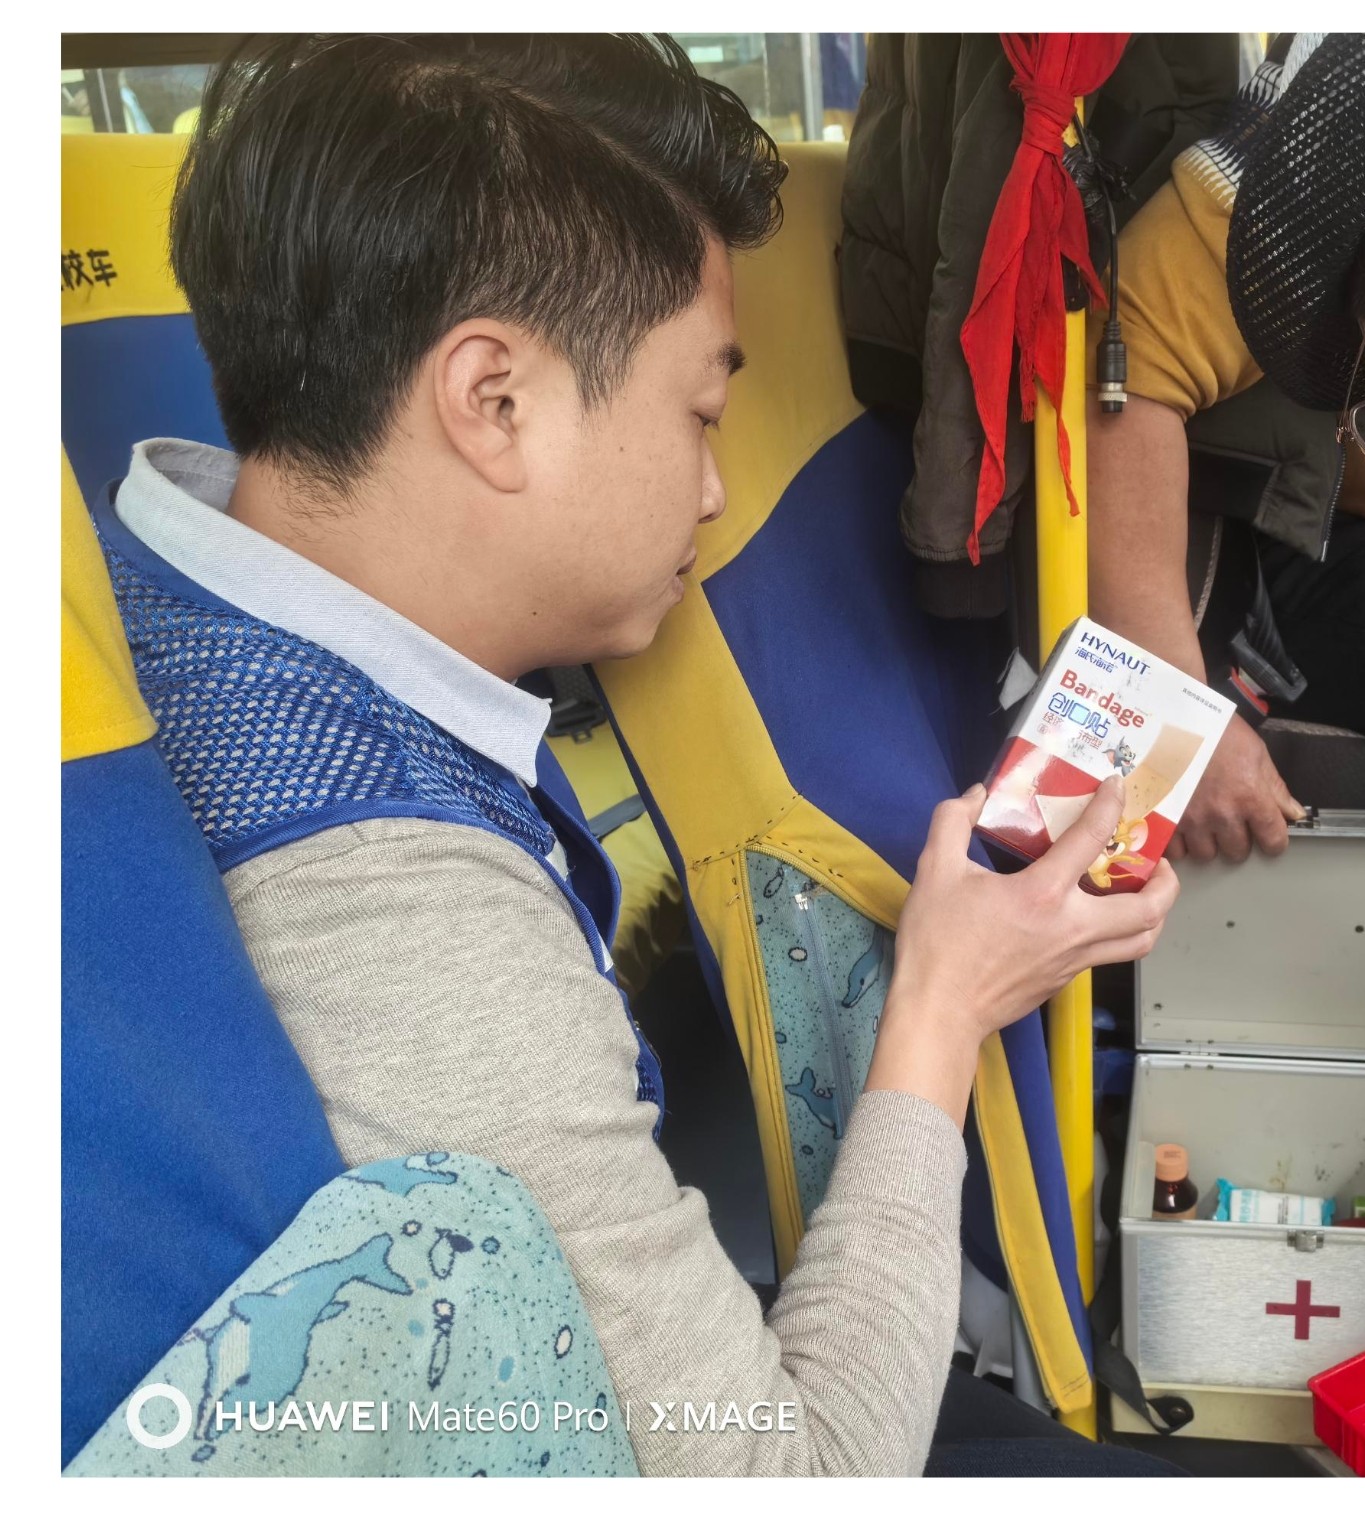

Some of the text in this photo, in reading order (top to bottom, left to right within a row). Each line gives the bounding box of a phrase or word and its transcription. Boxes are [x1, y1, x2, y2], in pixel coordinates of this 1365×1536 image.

[1081, 632, 1151, 676] HYNAUT
[1048, 692, 1112, 739] 创口贴
[1060, 669, 1145, 728] Bandage
